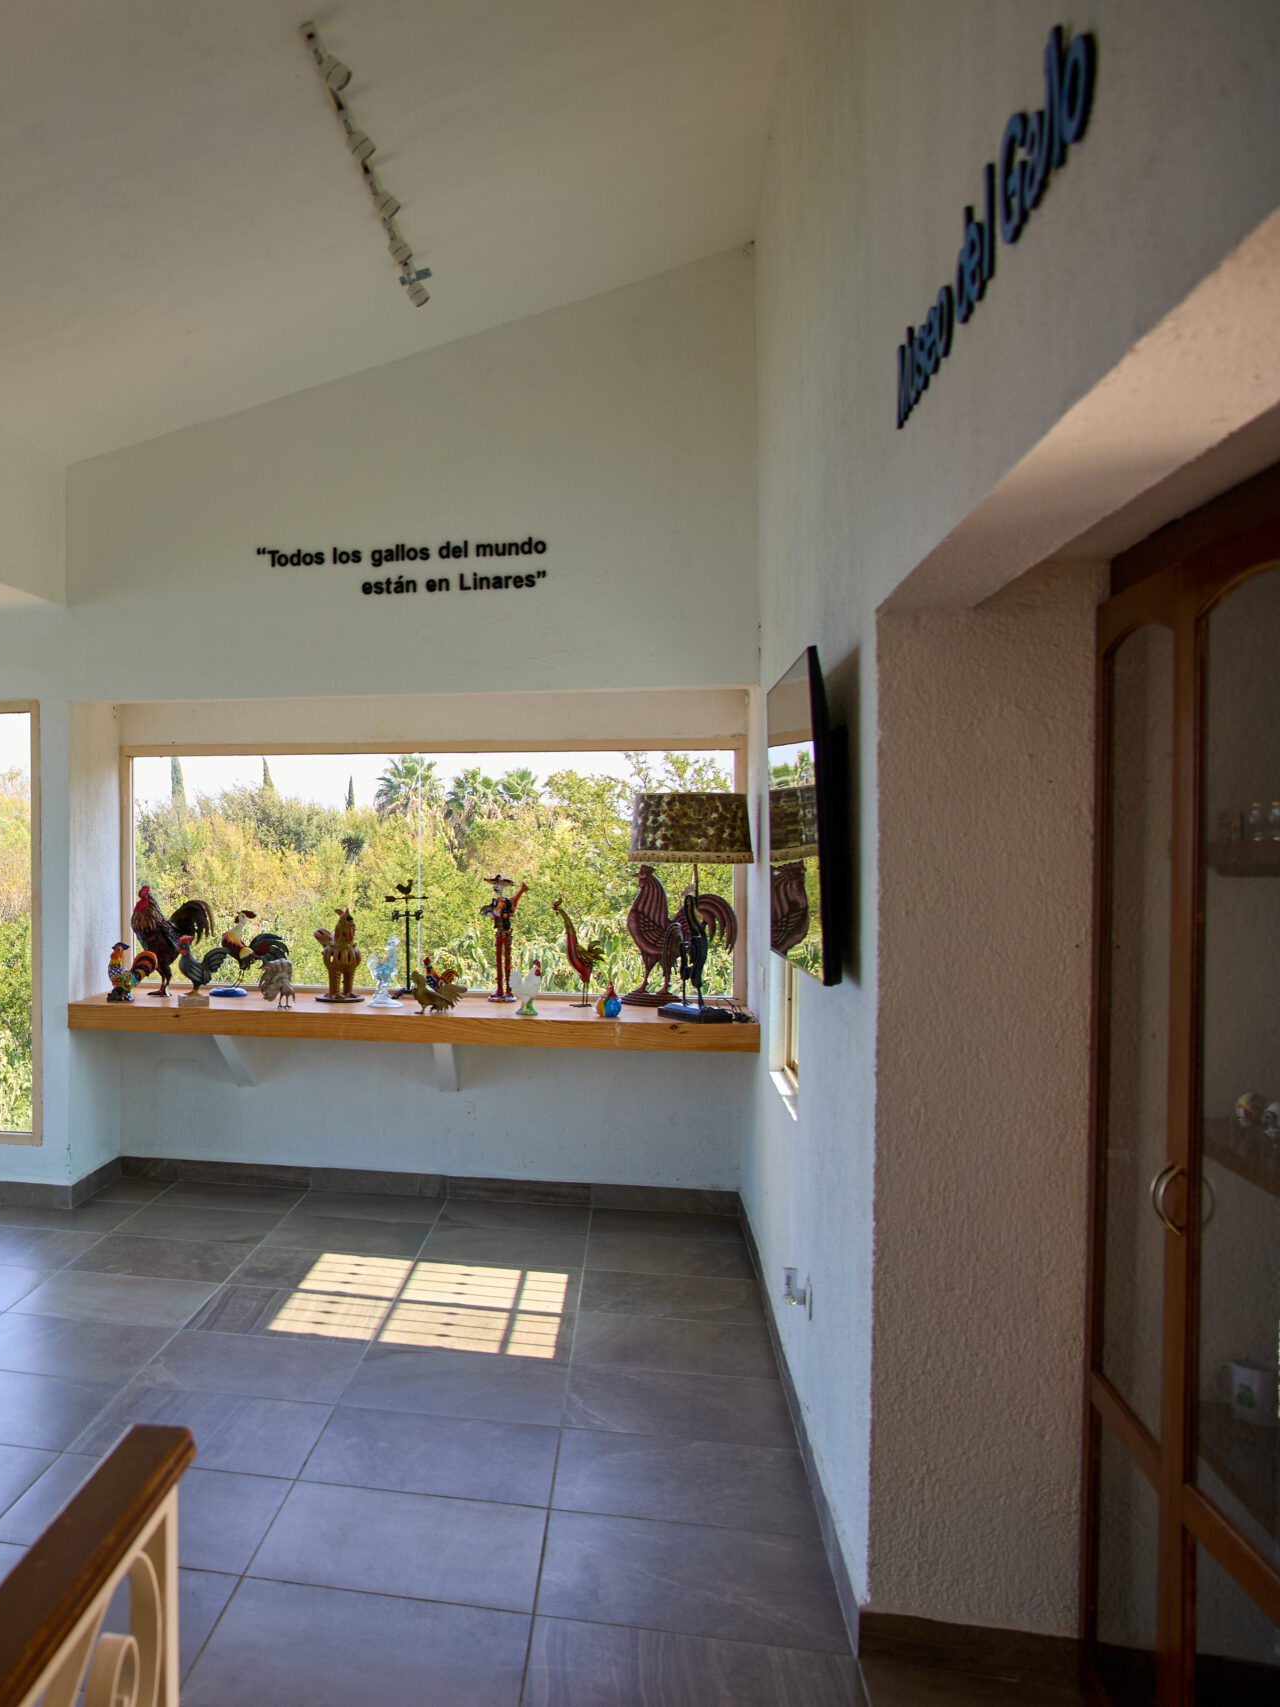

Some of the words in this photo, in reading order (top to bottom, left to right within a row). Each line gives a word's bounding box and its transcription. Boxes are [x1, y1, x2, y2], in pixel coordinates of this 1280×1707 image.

[957, 162, 996, 325] del
[256, 547, 325, 567] “Todos
[332, 547, 362, 564] los
[370, 544, 430, 567] gallos
[438, 540, 468, 559] del
[475, 536, 547, 557] mundo
[361, 575, 417, 595] están
[425, 578, 450, 592] en
[459, 570, 546, 591] Linares”
